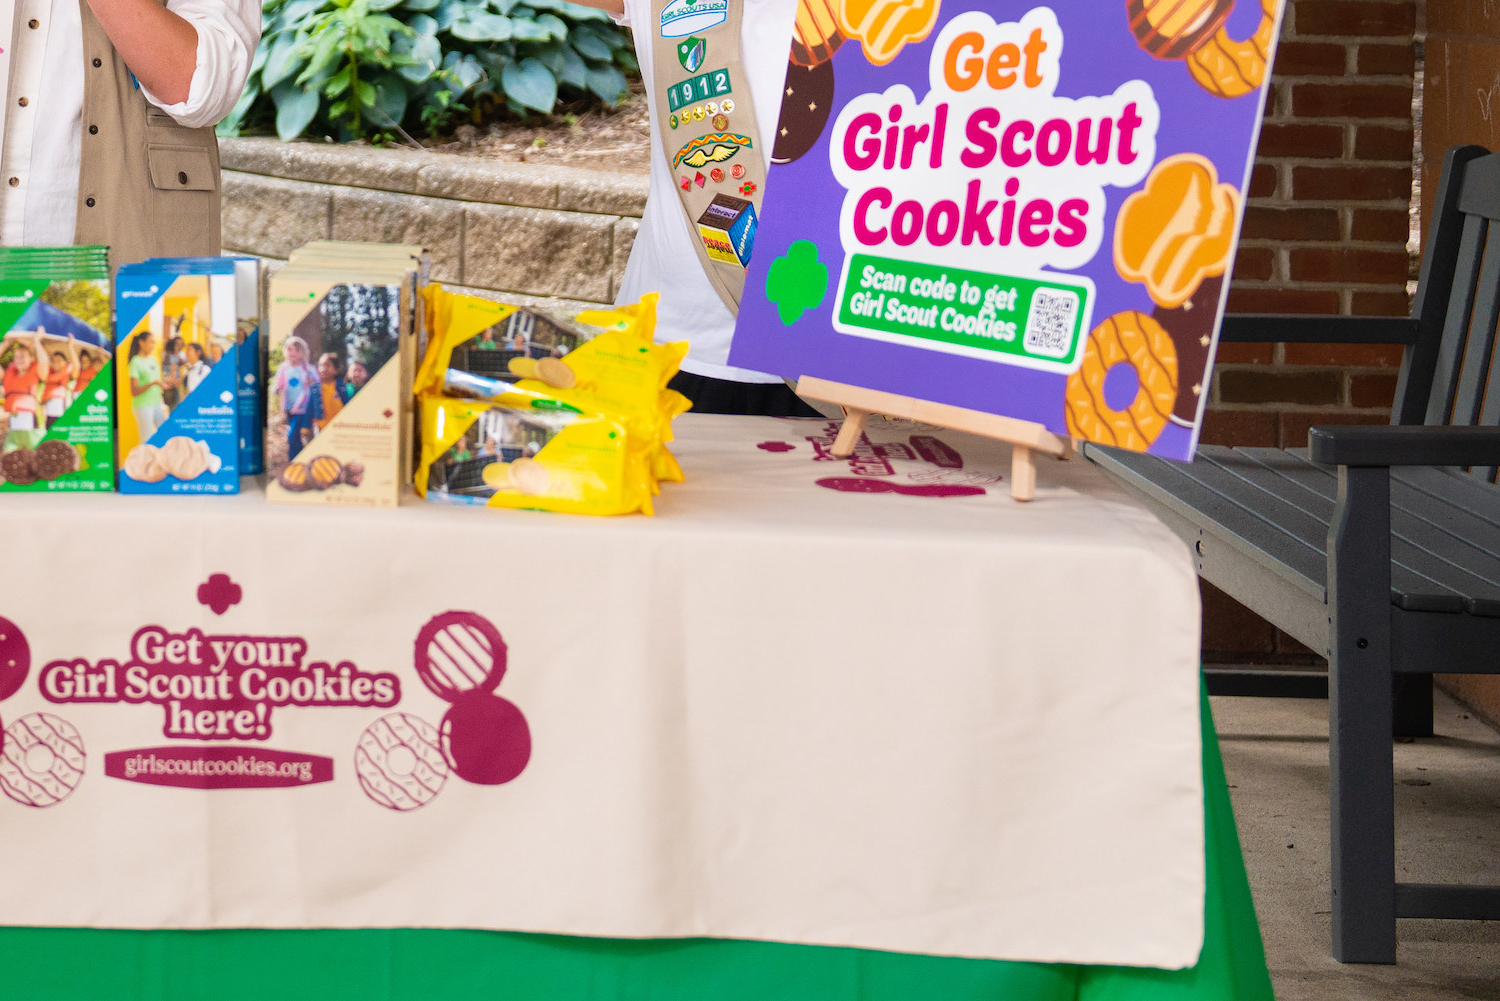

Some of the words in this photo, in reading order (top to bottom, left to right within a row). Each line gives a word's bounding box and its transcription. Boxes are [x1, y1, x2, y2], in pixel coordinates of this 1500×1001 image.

[676, 3, 709, 15] SCOUTS
[708, 2, 725, 10] USA
[943, 28, 1047, 92] Get
[670, 72, 728, 107] 1912
[842, 103, 948, 172] Girl
[960, 102, 1143, 169] Scout
[708, 204, 736, 219] interact
[852, 176, 1090, 248] Cookies
[738, 214, 754, 257] diplomat
[860, 264, 907, 293] Scan
[909, 274, 957, 302] code
[959, 280, 981, 305] to
[981, 284, 1018, 314] get
[849, 291, 886, 319] Girl
[884, 296, 939, 328] Scout
[940, 306, 1018, 342] Cookies
[135, 631, 203, 665] Get
[209, 637, 302, 673] your
[44, 662, 117, 699] Girl
[124, 665, 234, 700] Scout
[239, 667, 395, 702] Cookies
[168, 700, 268, 737] here!
[124, 754, 313, 782] girlscoutcookies.org
